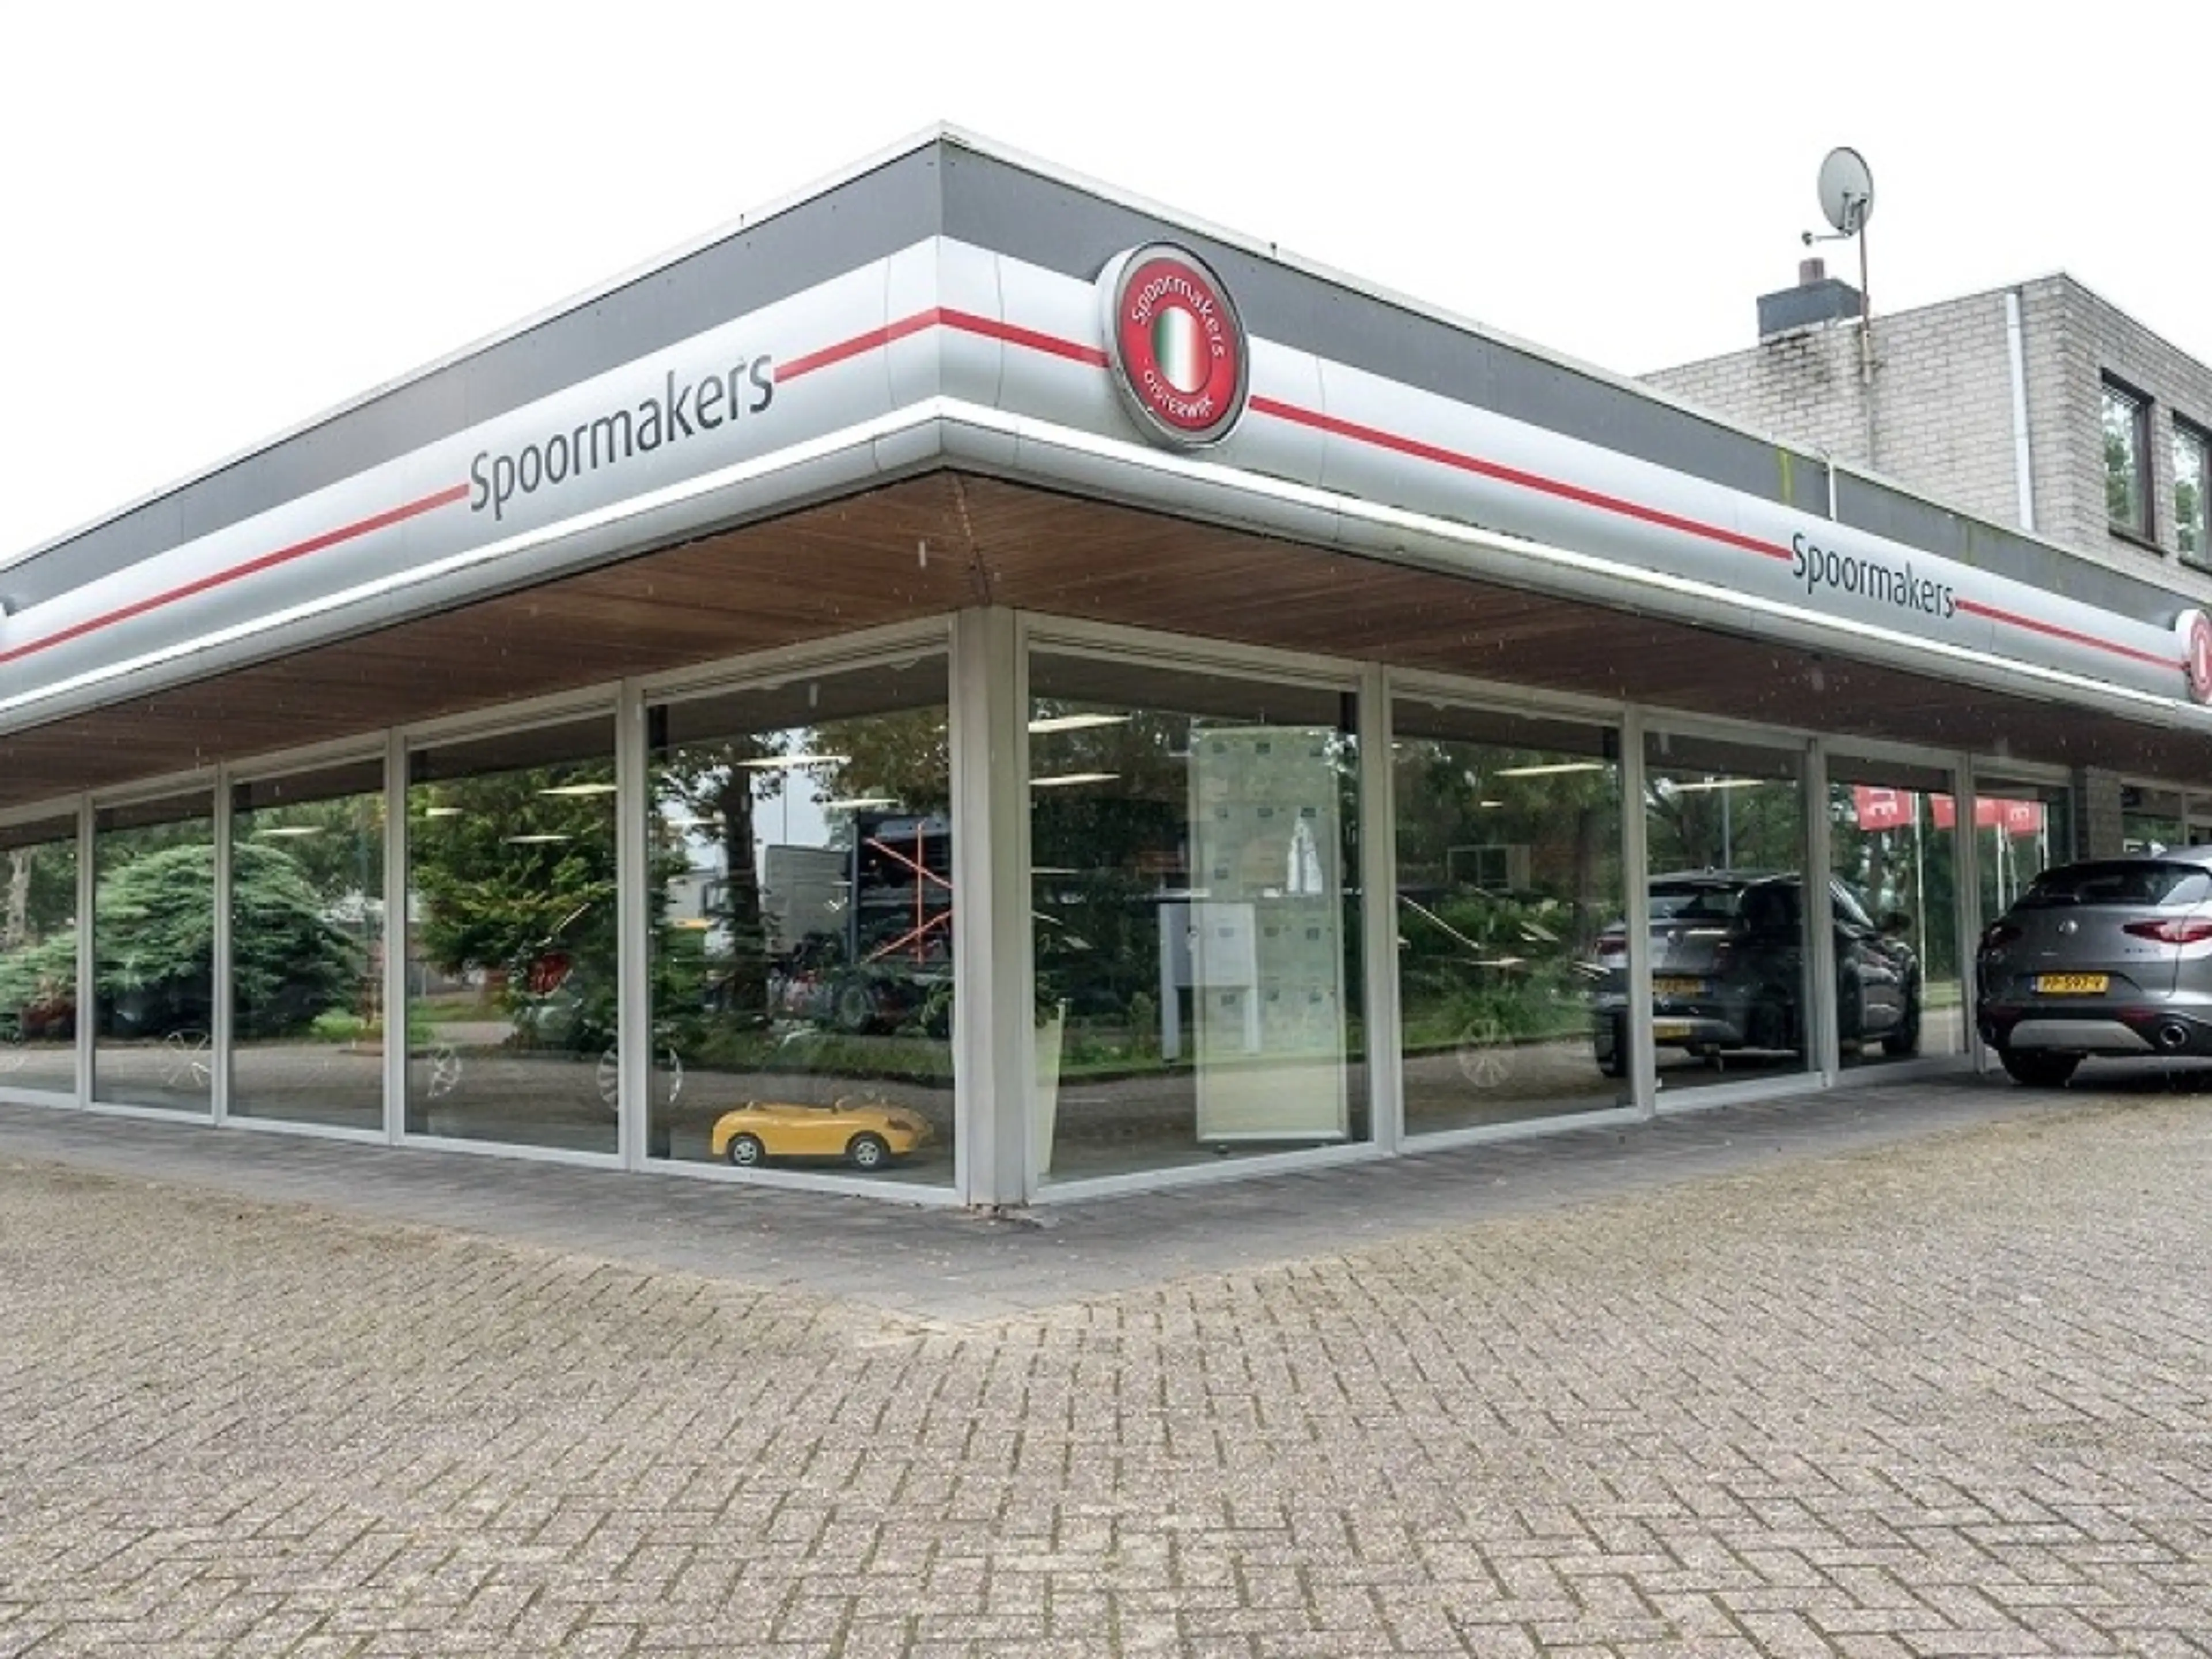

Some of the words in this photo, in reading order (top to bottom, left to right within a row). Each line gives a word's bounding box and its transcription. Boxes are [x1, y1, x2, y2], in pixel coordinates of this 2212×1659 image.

[1131, 275, 1225, 358] Spoormakers
[470, 354, 773, 521] Spoormakers
[1792, 532, 1955, 619] Spoormakers
